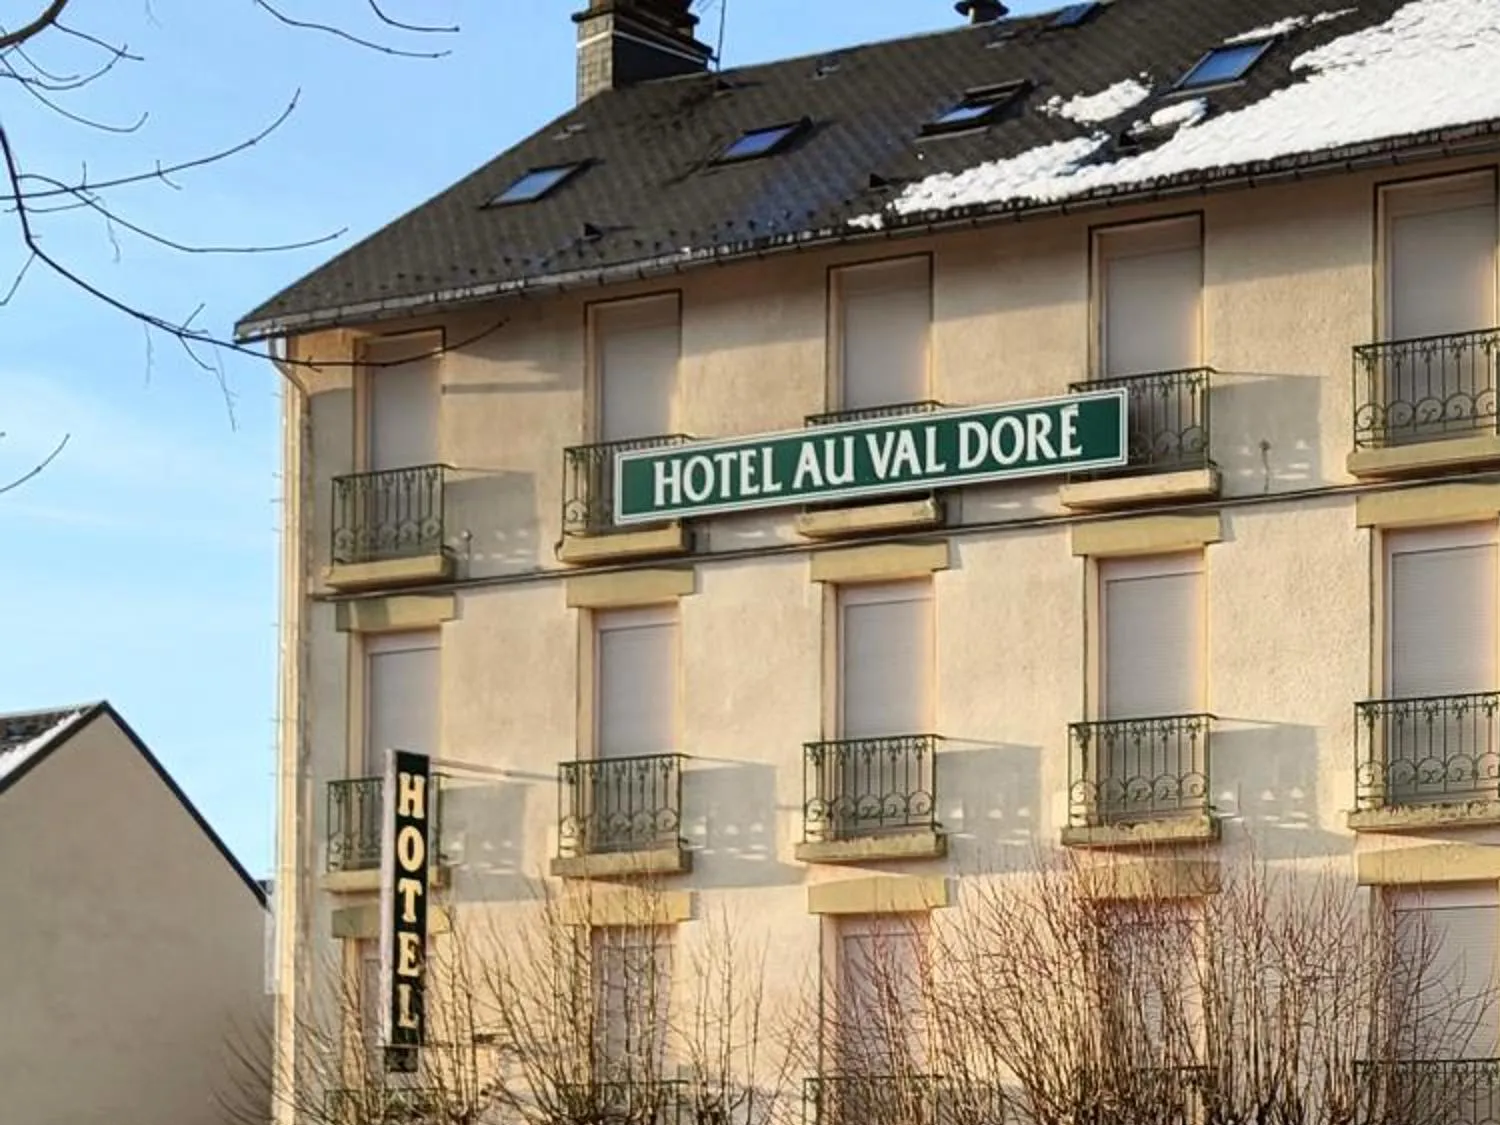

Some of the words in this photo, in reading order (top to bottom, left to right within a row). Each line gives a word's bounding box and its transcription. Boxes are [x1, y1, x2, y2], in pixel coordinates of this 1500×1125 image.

[653, 445, 781, 507] HOTEL
[792, 437, 855, 488] AU
[865, 426, 947, 479] VAL
[397, 771, 425, 1029] HOTEL
